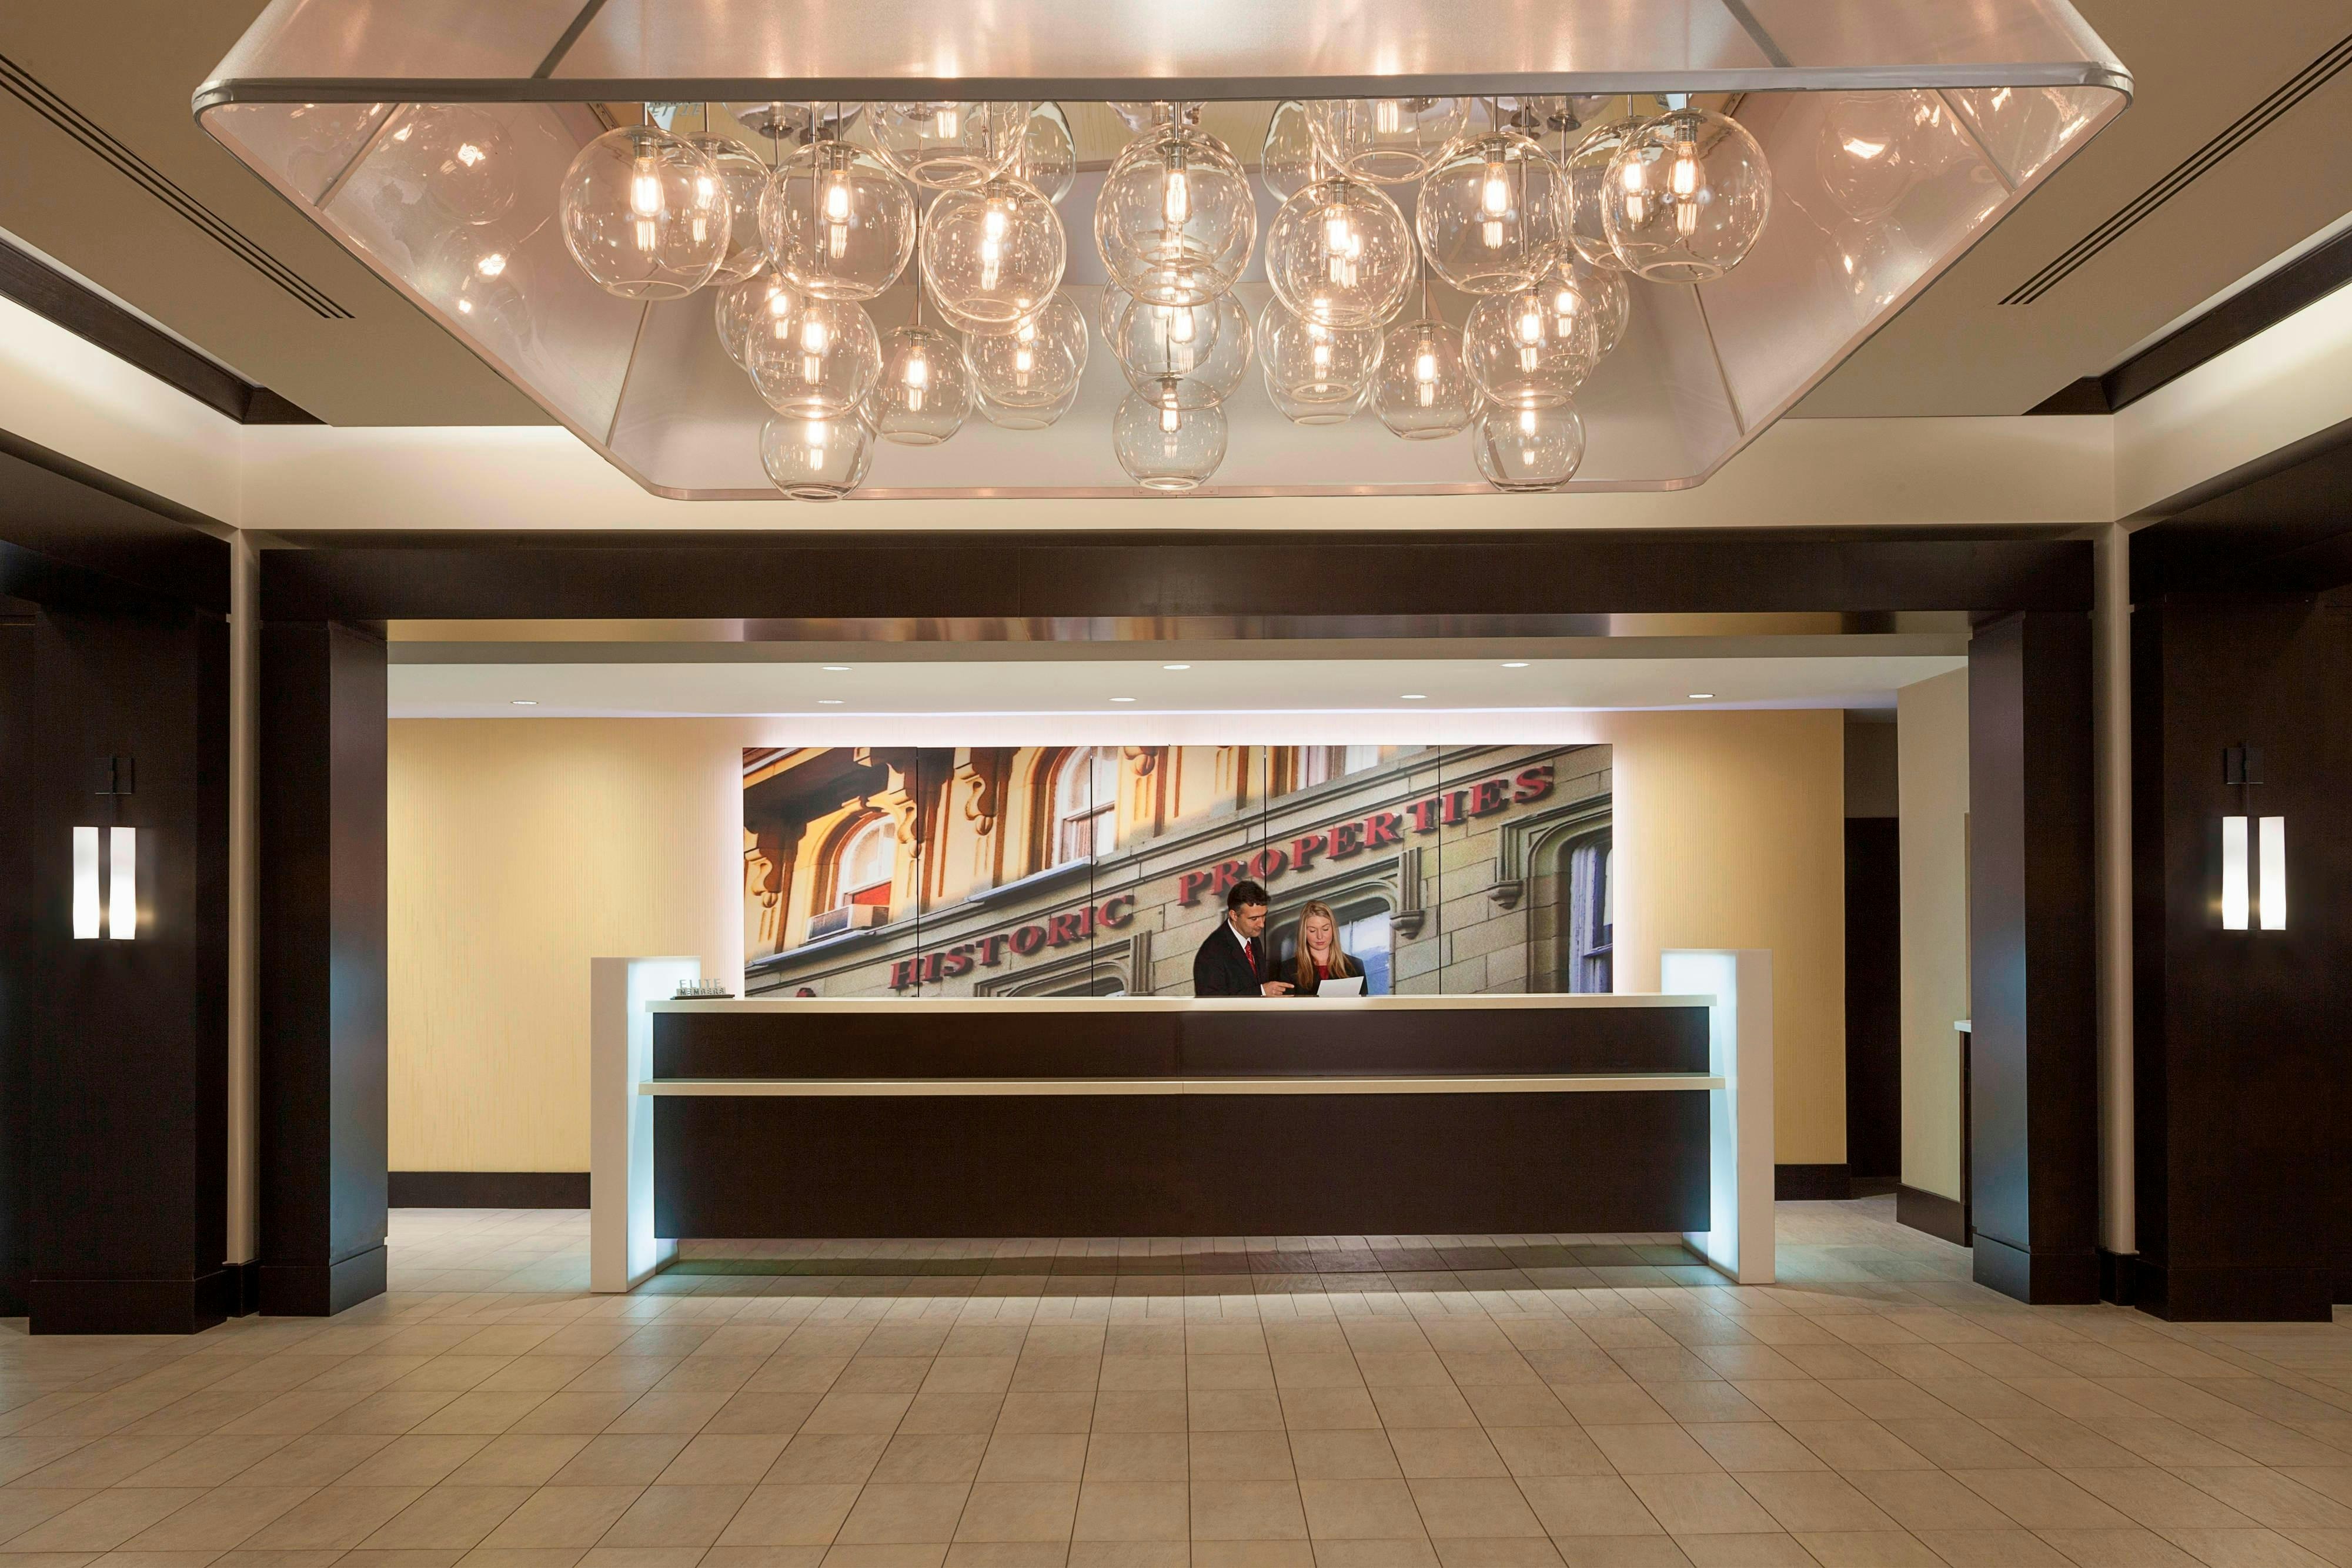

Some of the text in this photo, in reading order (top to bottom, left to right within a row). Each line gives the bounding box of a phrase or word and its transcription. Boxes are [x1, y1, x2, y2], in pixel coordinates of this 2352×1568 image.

[888, 765, 1555, 989] HISTORIC PROPERTIES
[679, 978, 721, 988] ELITE
